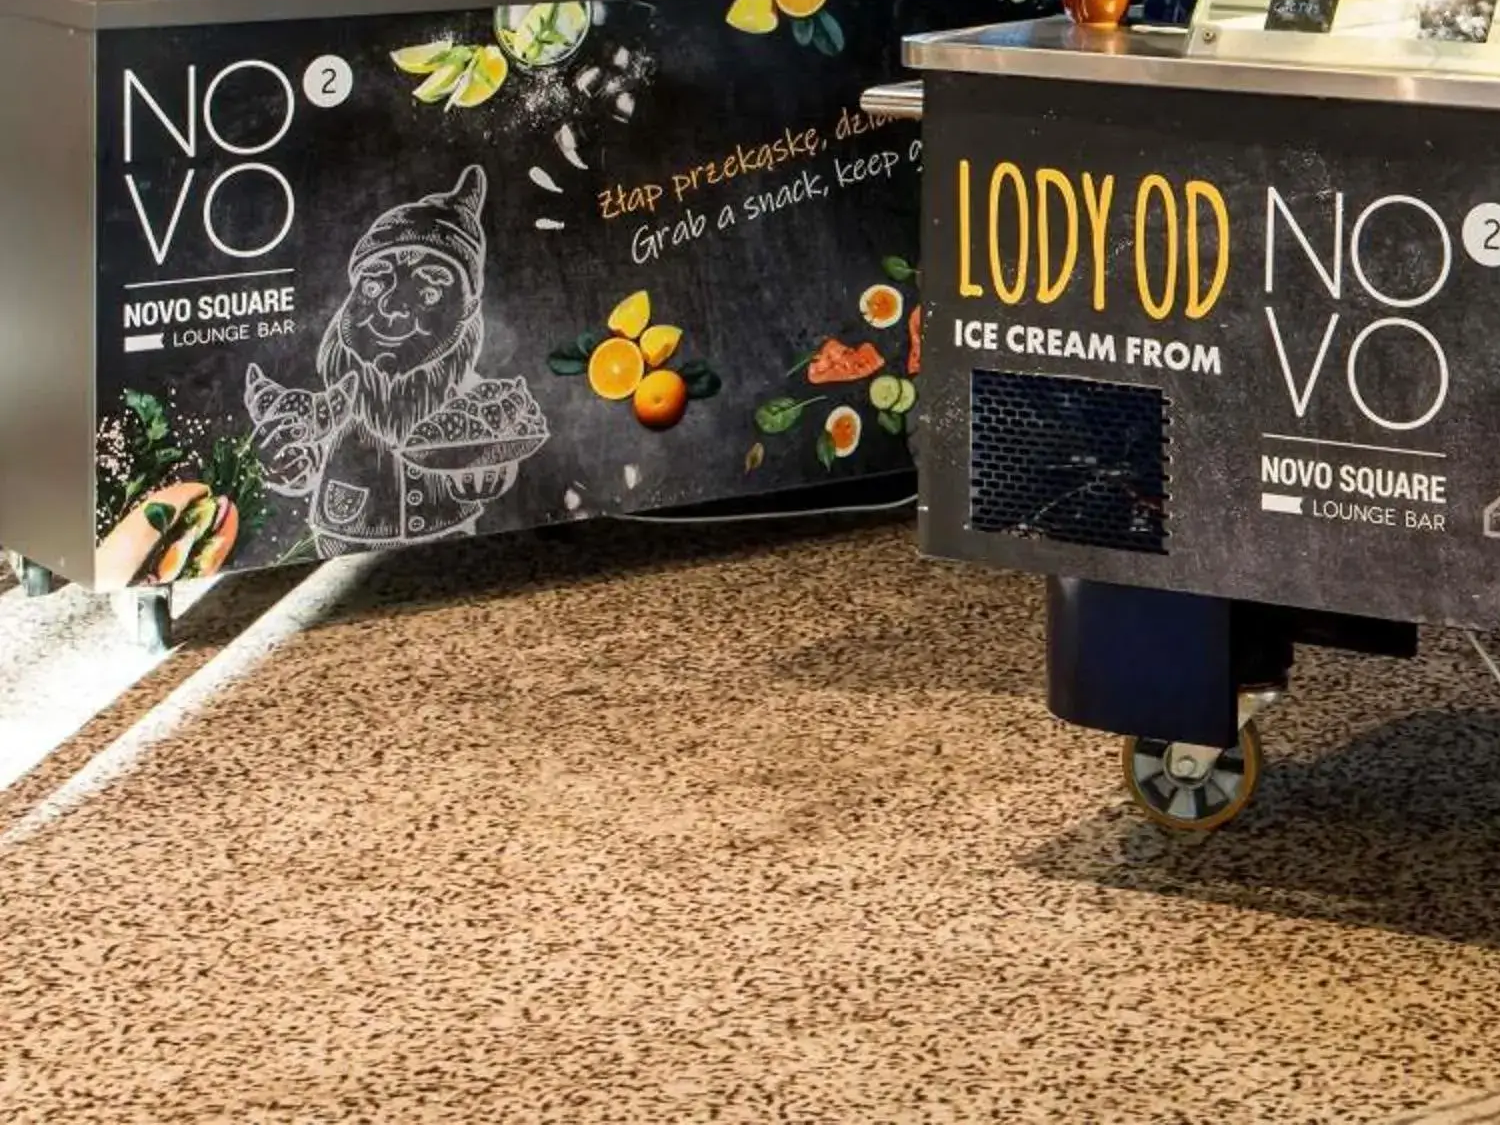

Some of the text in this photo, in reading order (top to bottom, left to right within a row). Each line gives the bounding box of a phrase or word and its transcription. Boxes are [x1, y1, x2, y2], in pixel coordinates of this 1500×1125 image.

[123, 59, 337, 163] NO 2
[671, 126, 828, 203] przekąskę,
[835, 106, 897, 140] dzia
[124, 162, 295, 266] VO
[631, 208, 707, 264] Grab
[717, 204, 736, 230] a
[743, 170, 830, 221] snack,
[834, 150, 900, 188] keep
[957, 159, 1231, 320] LODY OD
[1264, 185, 1454, 308] NO
[123, 286, 295, 329] NOVO SQUARE
[173, 319, 296, 348] LOUNGE BAR
[953, 318, 1223, 376] ICE CREAM FROM
[1264, 306, 1450, 431] VO
[1260, 454, 1448, 505] NOVO SQUARE
[1312, 497, 1447, 533] LOUNGE BAR
